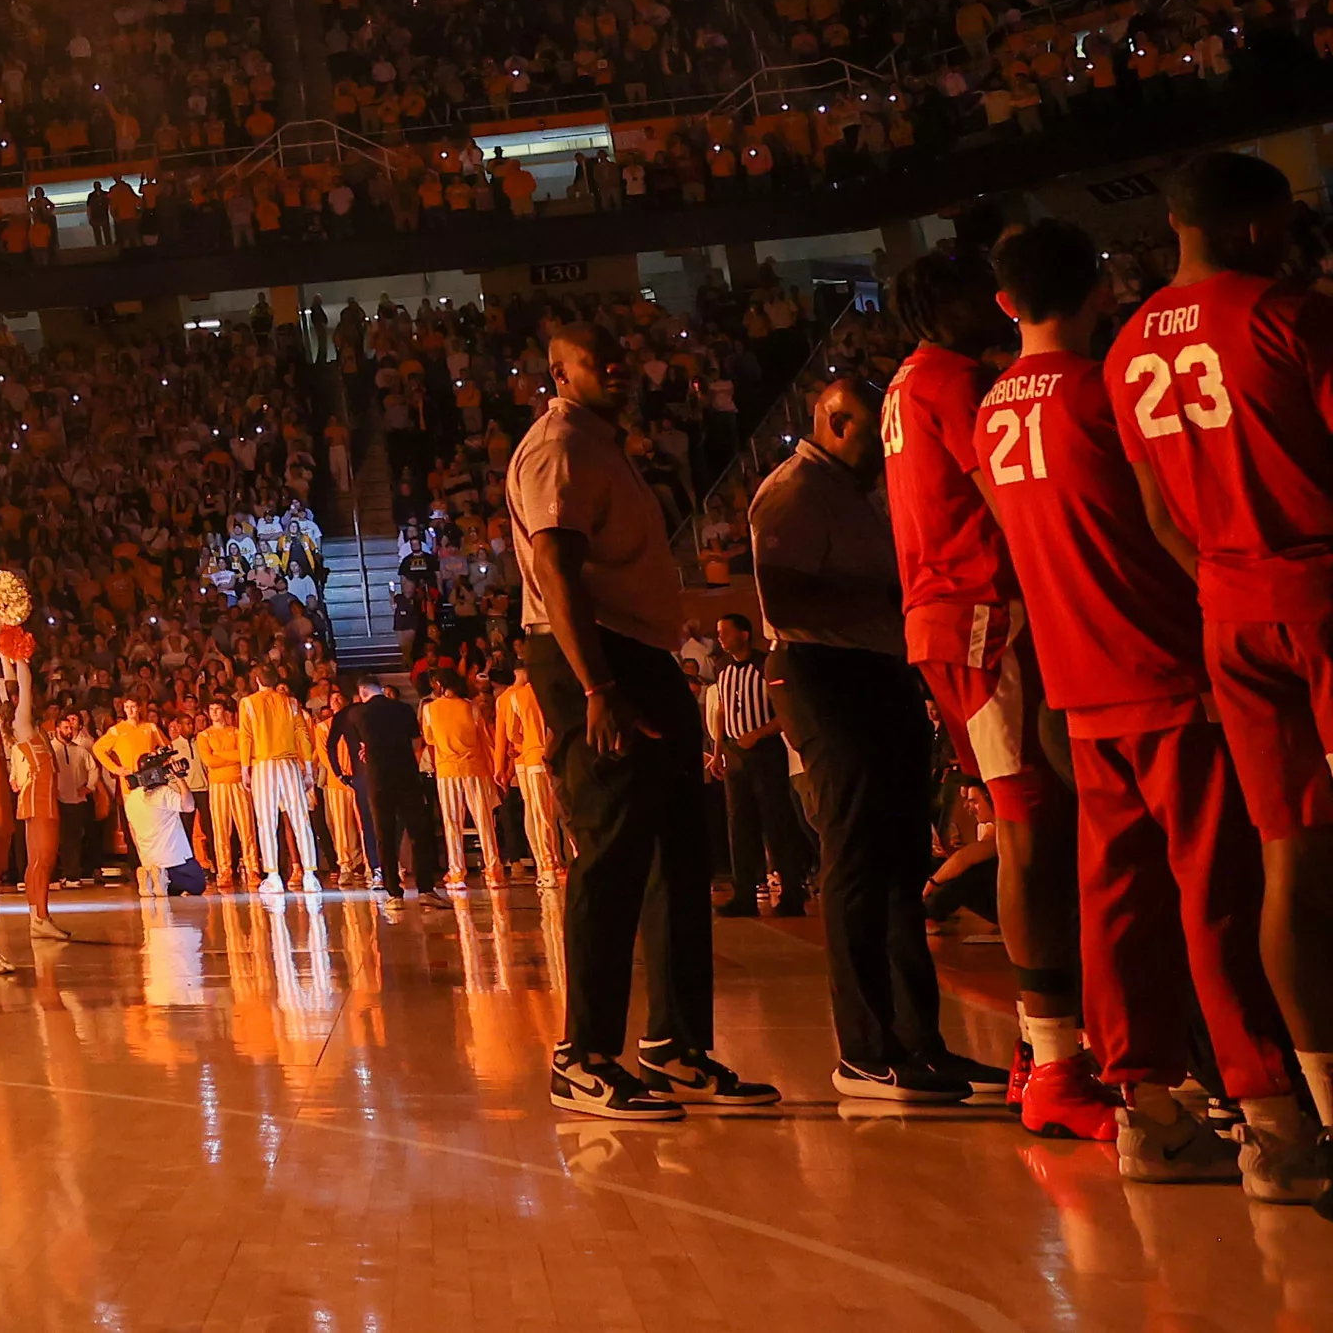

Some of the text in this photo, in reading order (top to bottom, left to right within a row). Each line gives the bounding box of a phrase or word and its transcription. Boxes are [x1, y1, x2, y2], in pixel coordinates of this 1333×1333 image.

[1098, 177, 1149, 200] 131
[539, 264, 581, 283] 130
[1143, 304, 1200, 339] FORD
[1125, 342, 1233, 439] 23
[986, 403, 1048, 486] 21
